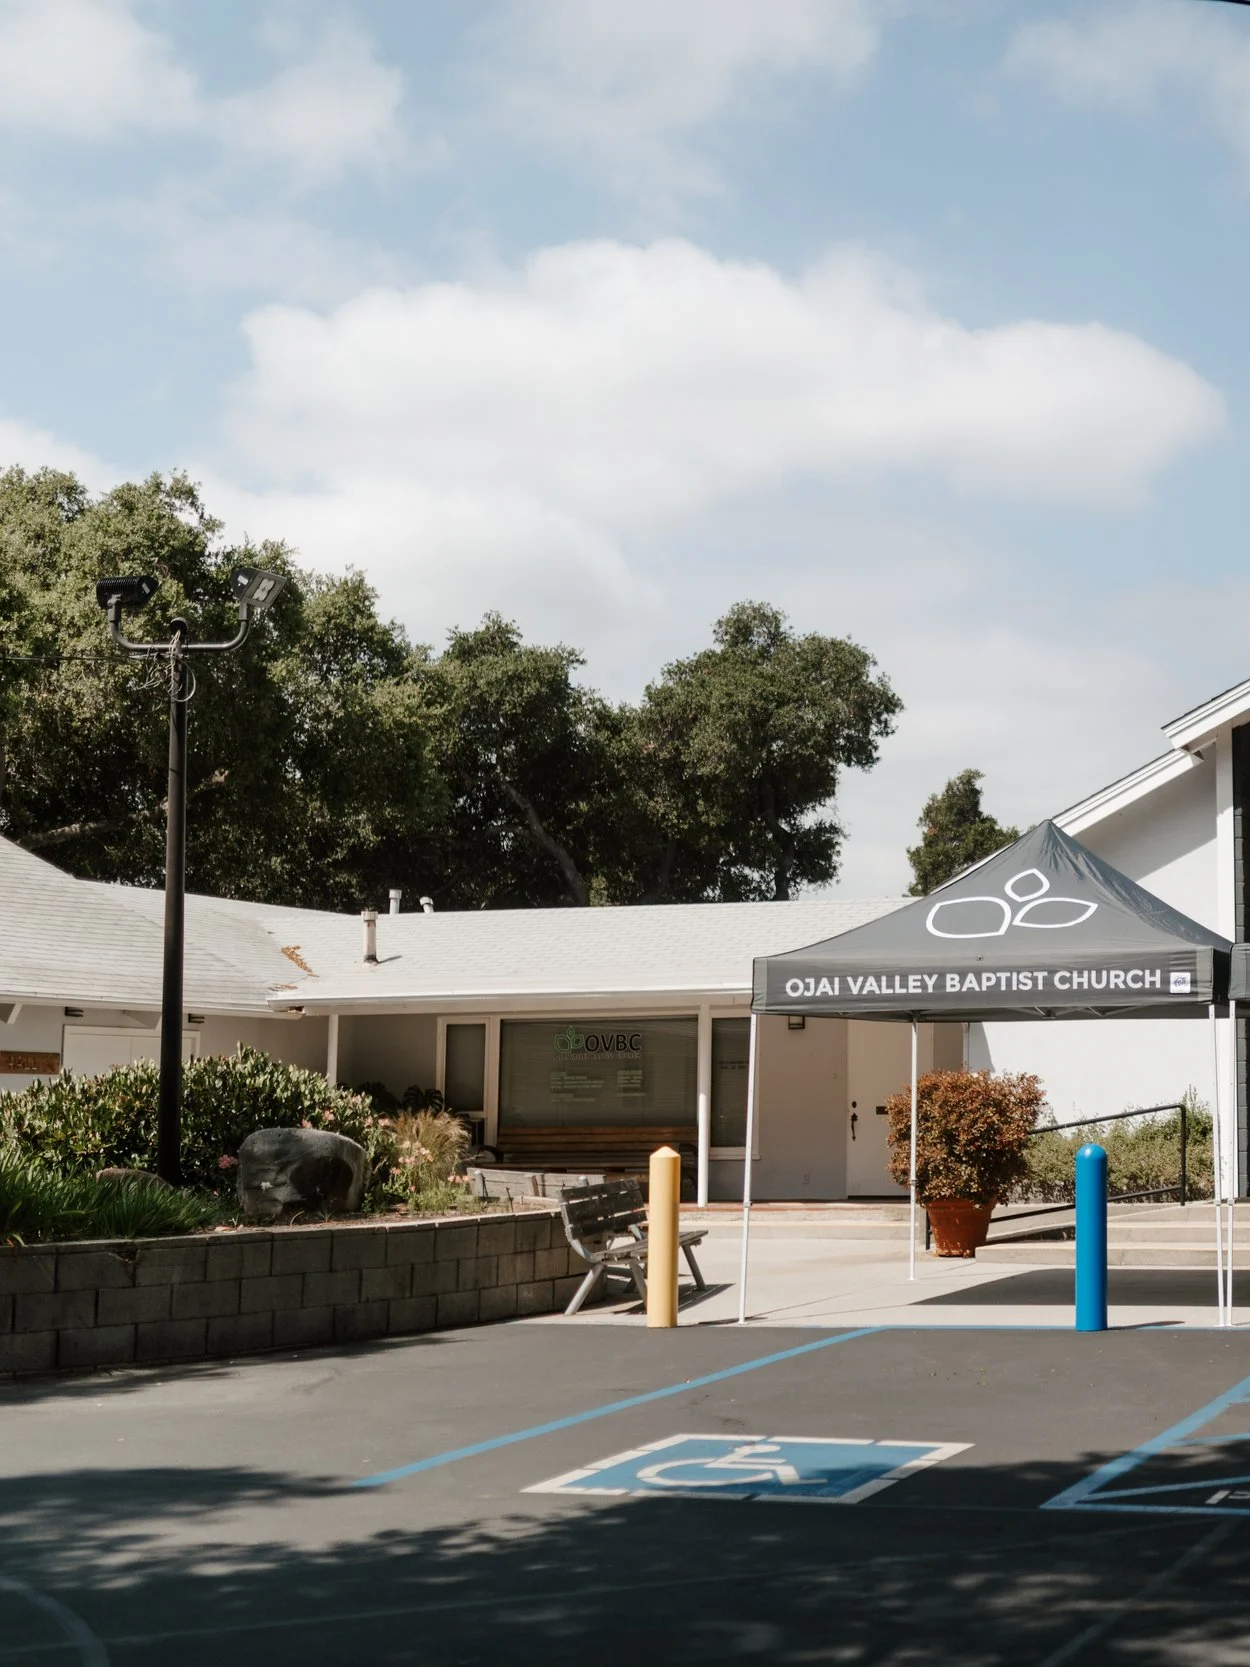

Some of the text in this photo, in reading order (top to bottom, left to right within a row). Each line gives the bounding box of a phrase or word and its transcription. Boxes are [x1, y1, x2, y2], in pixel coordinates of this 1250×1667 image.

[785, 976, 839, 997] OJAI
[846, 973, 938, 996] VALLEY
[945, 970, 1048, 993] BAPTIST
[1053, 969, 1161, 990] CHURCH
[584, 1033, 642, 1053] OVBC
